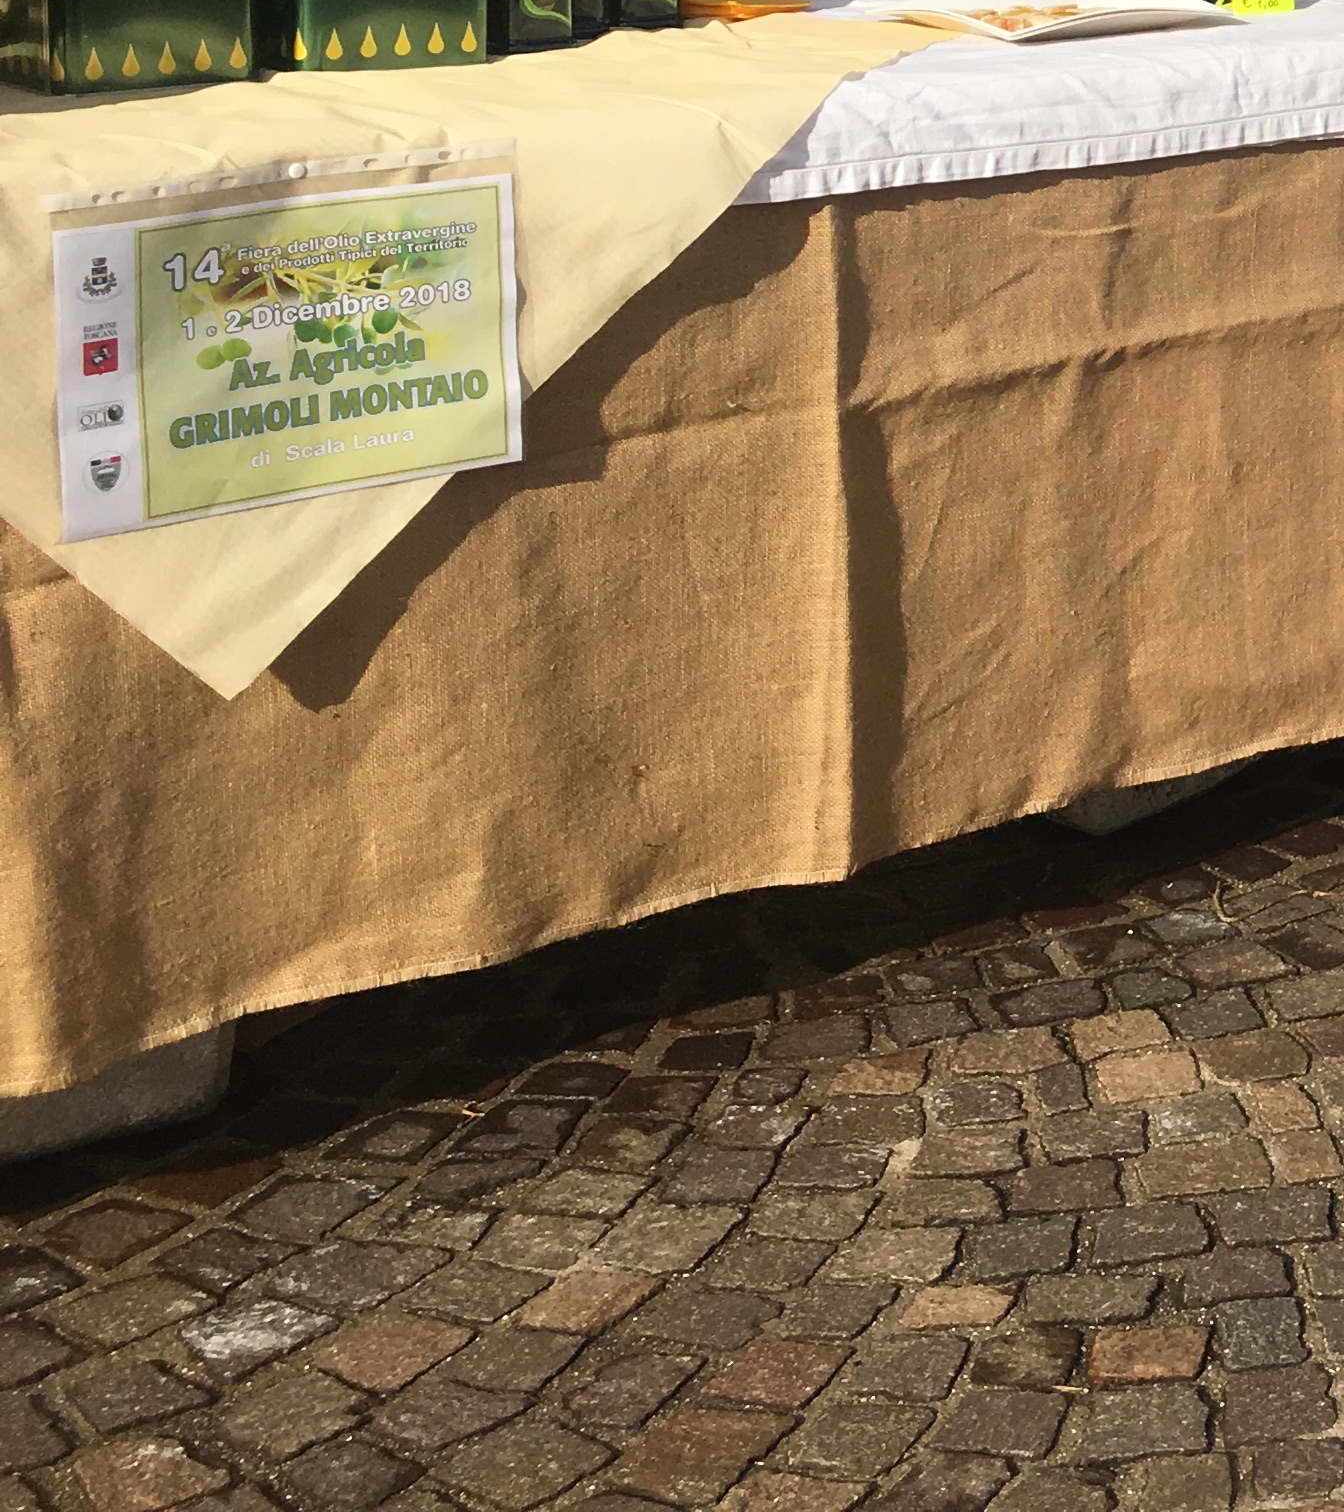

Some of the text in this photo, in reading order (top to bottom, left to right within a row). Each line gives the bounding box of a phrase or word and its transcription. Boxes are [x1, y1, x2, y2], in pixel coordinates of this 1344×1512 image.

[237, 244, 282, 262] Fiera
[365, 220, 478, 245] Extravergine
[240, 236, 470, 275] e dei Prodotti Tipici del Territorio
[181, 316, 195, 340] 1
[223, 310, 243, 335] 2
[251, 291, 390, 331] Dicembre
[399, 278, 472, 309] 2018
[228, 330, 426, 392] Az. Agricola
[168, 368, 489, 451] GRIMOLI MONTAIO
[251, 427, 415, 469] di Scala Laura
